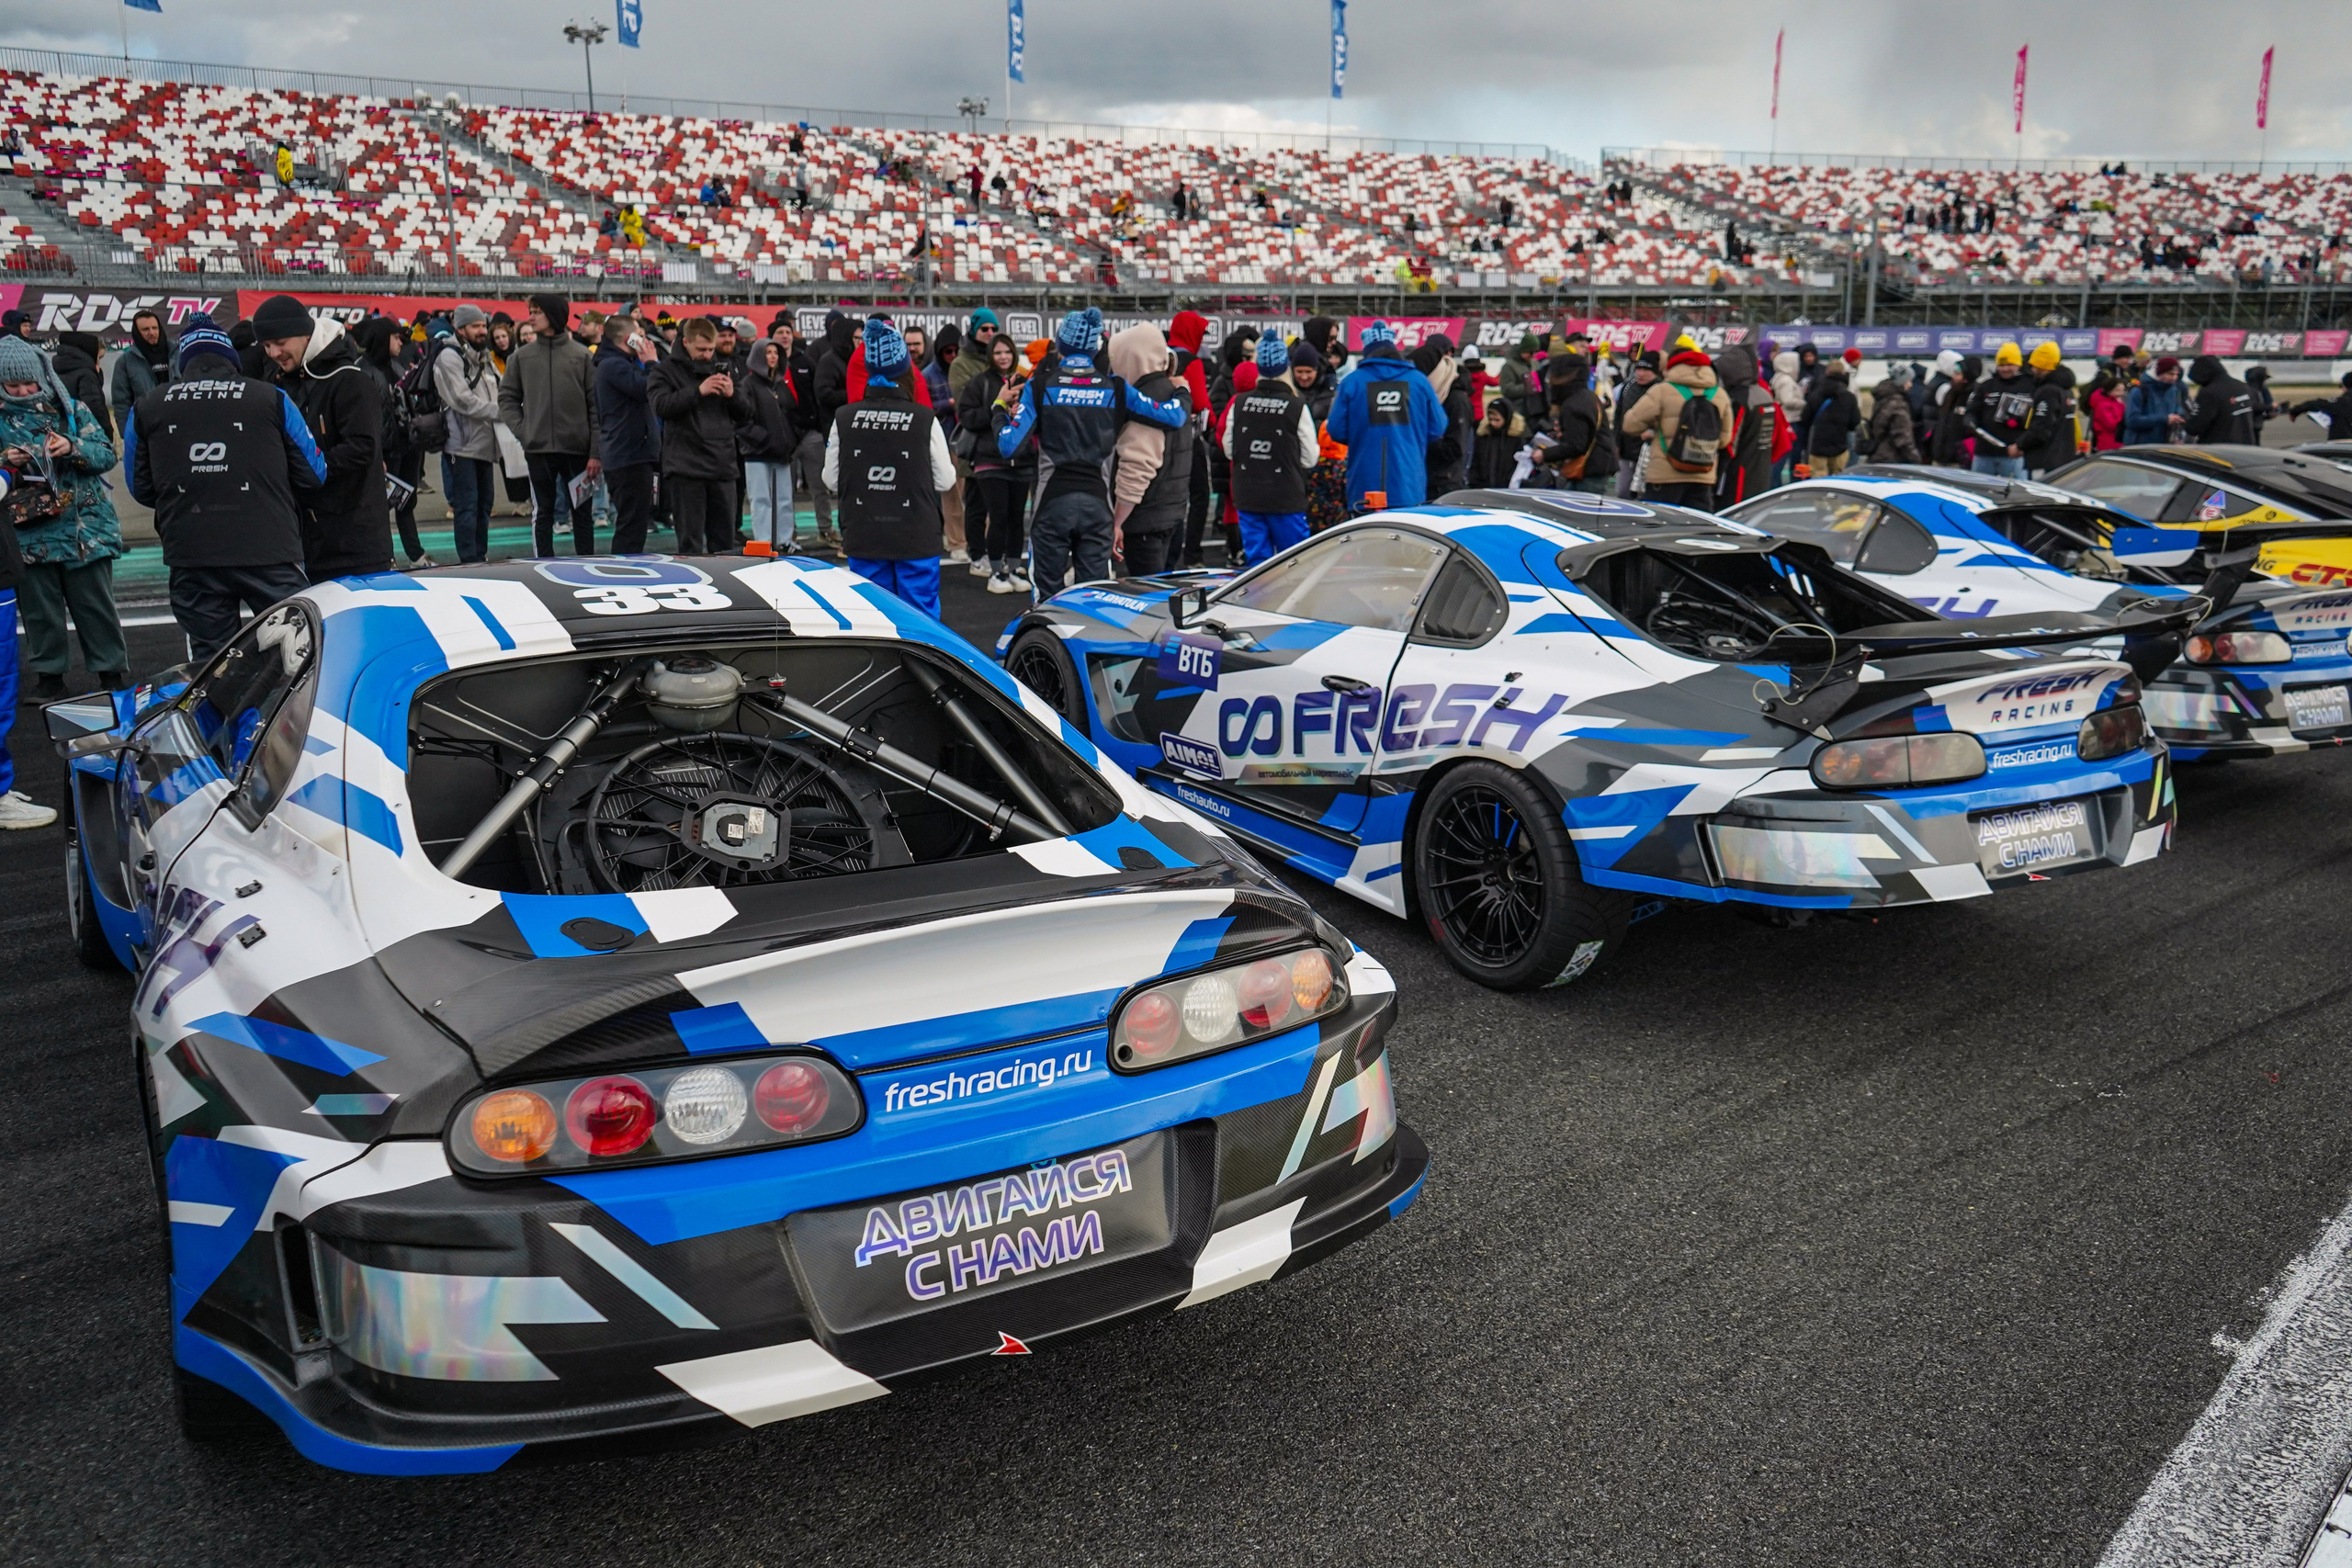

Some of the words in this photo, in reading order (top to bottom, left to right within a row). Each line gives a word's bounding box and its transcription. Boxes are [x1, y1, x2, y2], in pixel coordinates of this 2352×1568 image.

[37, 293, 164, 332] RDS
[167, 296, 221, 325] TV
[801, 314, 827, 330] LEVE
[1476, 321, 1529, 345] RDS
[1724, 327, 1748, 344] TV
[2143, 332, 2180, 352] RDS
[2245, 332, 2282, 352] RDS
[164, 391, 243, 401] RACING
[1057, 397, 1102, 405] RACING
[1241, 405, 1286, 415] RACING
[851, 421, 910, 431] RACING
[572, 583, 733, 615] 33
[1178, 644, 1215, 678] ВТБ
[1991, 699, 2075, 724] RACING
[1992, 743, 2074, 769] freshracing.ru
[1177, 785, 1231, 818] freshauto.ru
[1978, 802, 2085, 847] ДВИГАЙСЯ
[2014, 830, 2076, 866] НАМИ
[884, 1048, 1092, 1113] freshracing.ru
[854, 1148, 1133, 1268] ДВИГАЙСЯ
[905, 1252, 947, 1301] С
[951, 1209, 1105, 1293] НАМИ
